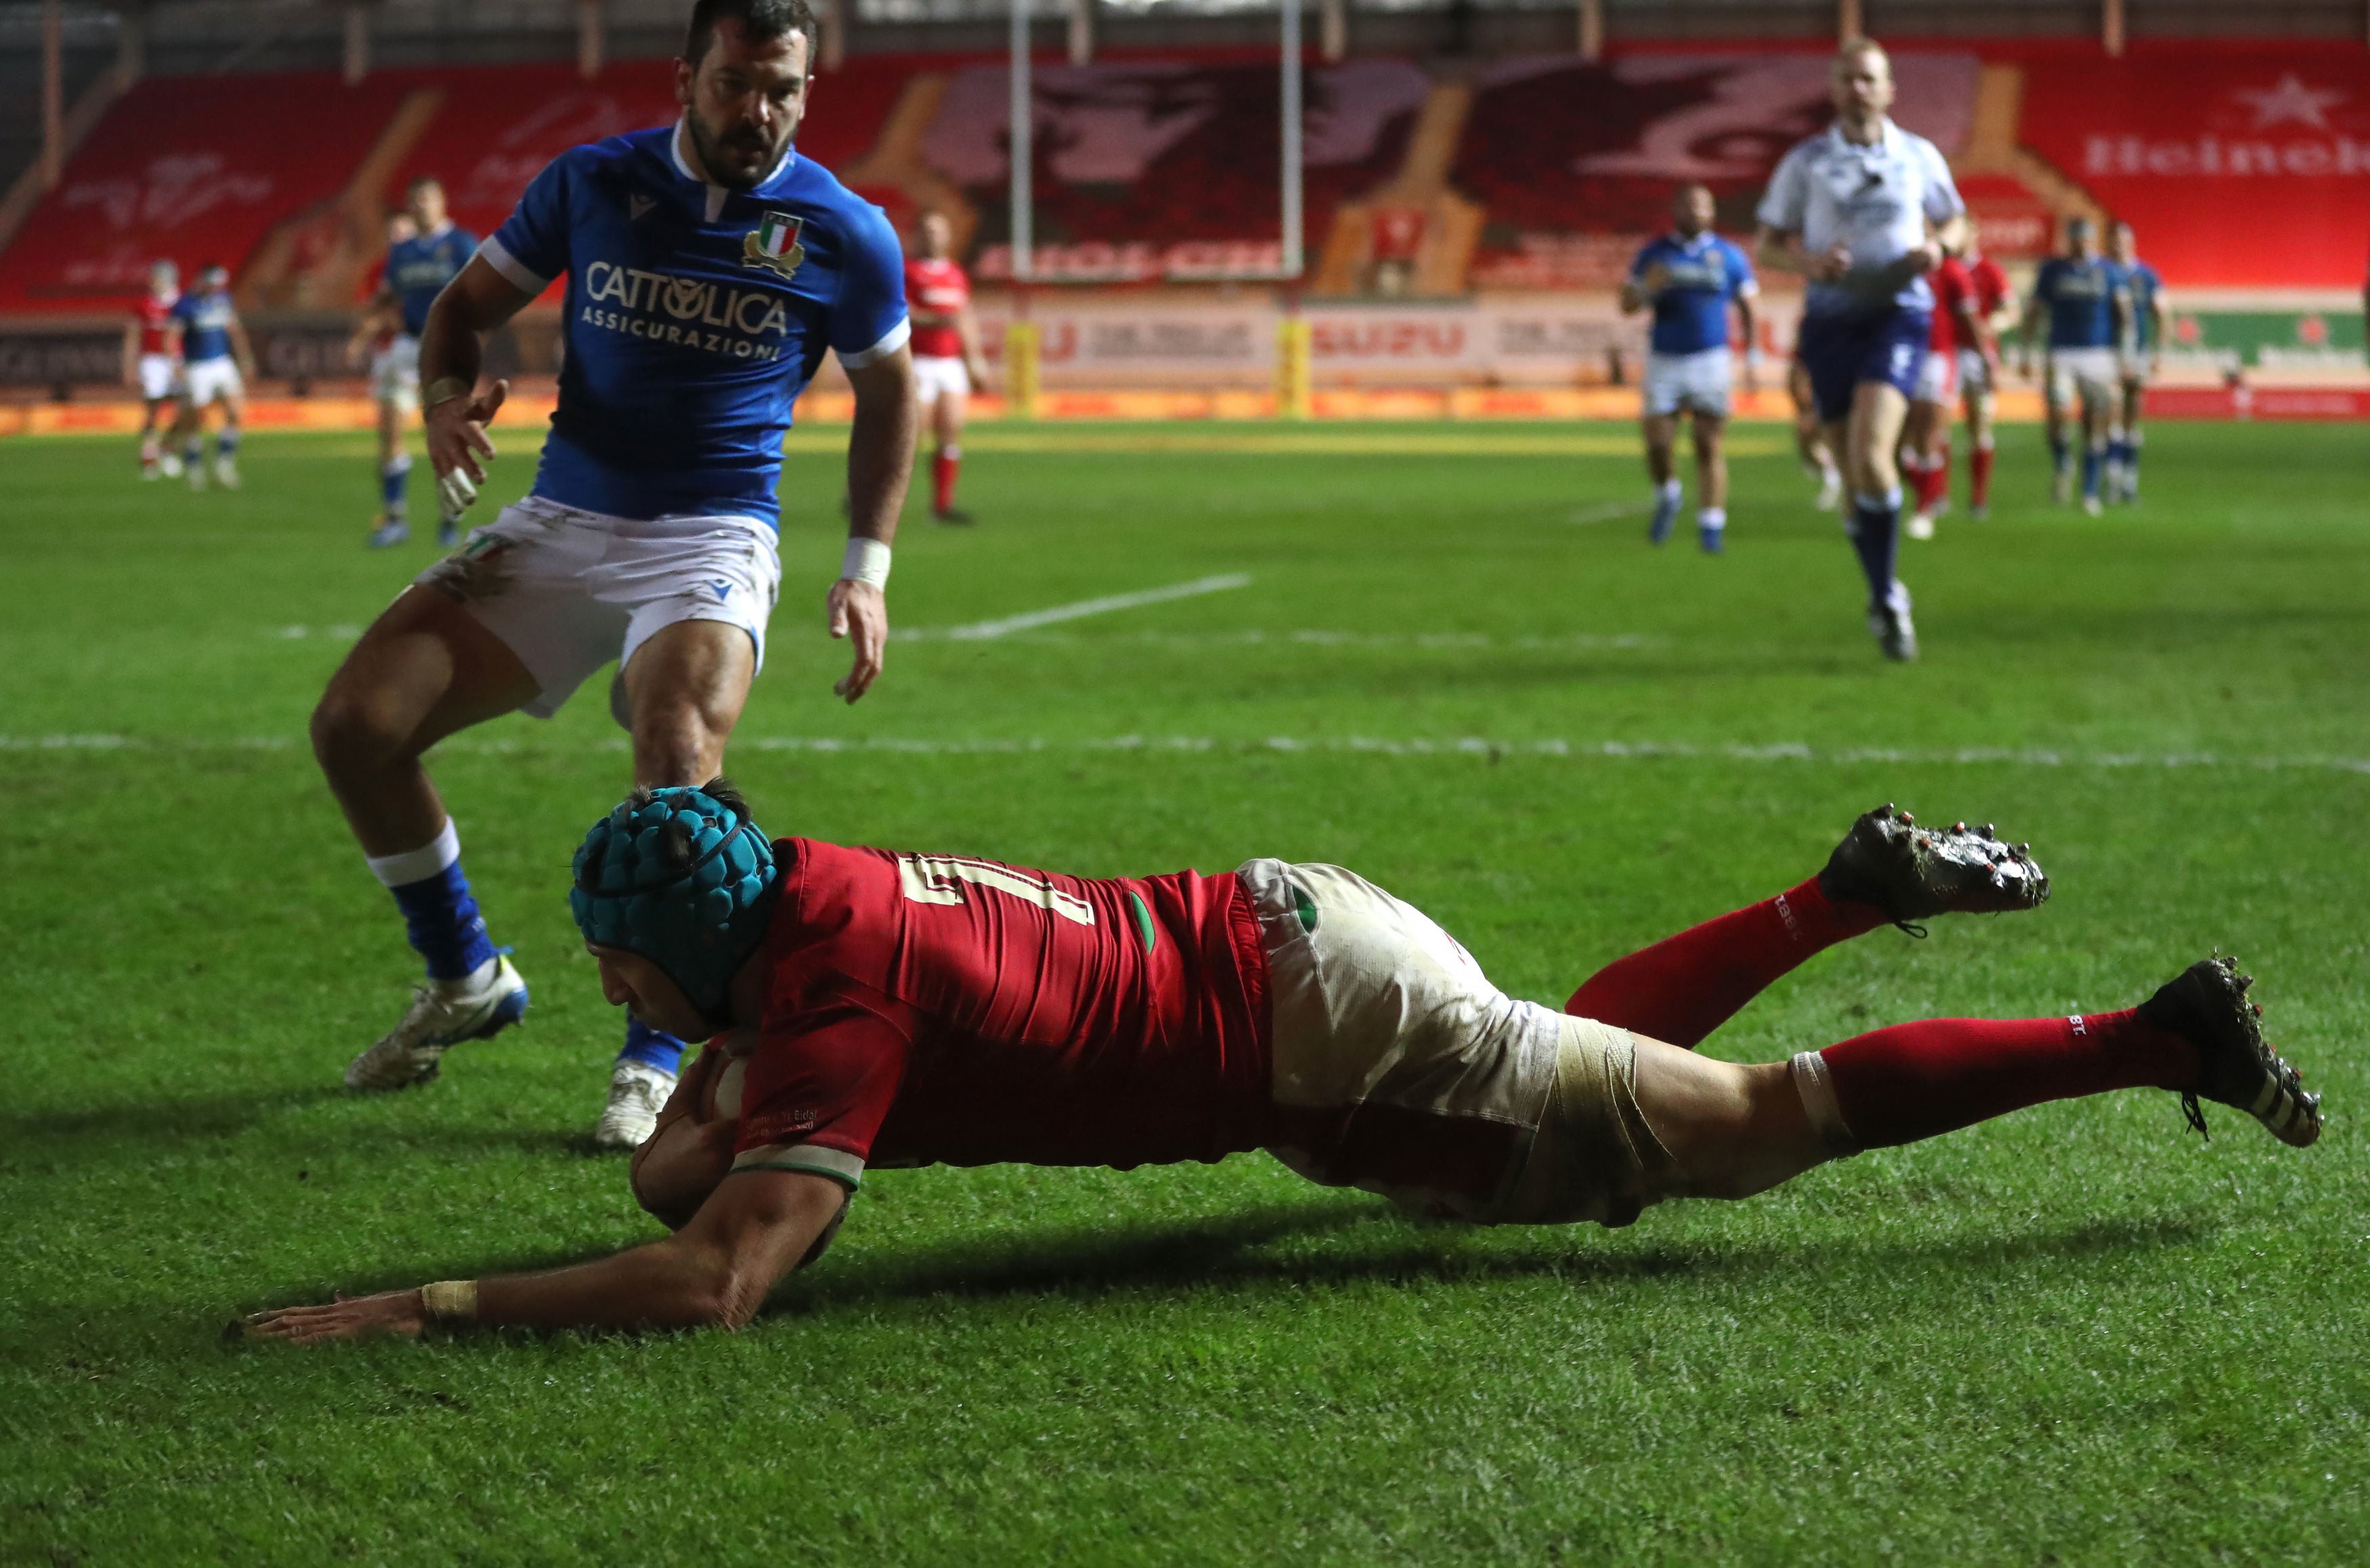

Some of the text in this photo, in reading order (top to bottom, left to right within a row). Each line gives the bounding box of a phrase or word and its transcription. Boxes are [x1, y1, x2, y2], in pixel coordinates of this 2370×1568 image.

[586, 261, 788, 337] CATTOLICA
[581, 306, 782, 362] ASSICURAZIONI
[1311, 322, 1466, 357] SUZU
[794, 1109, 818, 1120] Eidal
